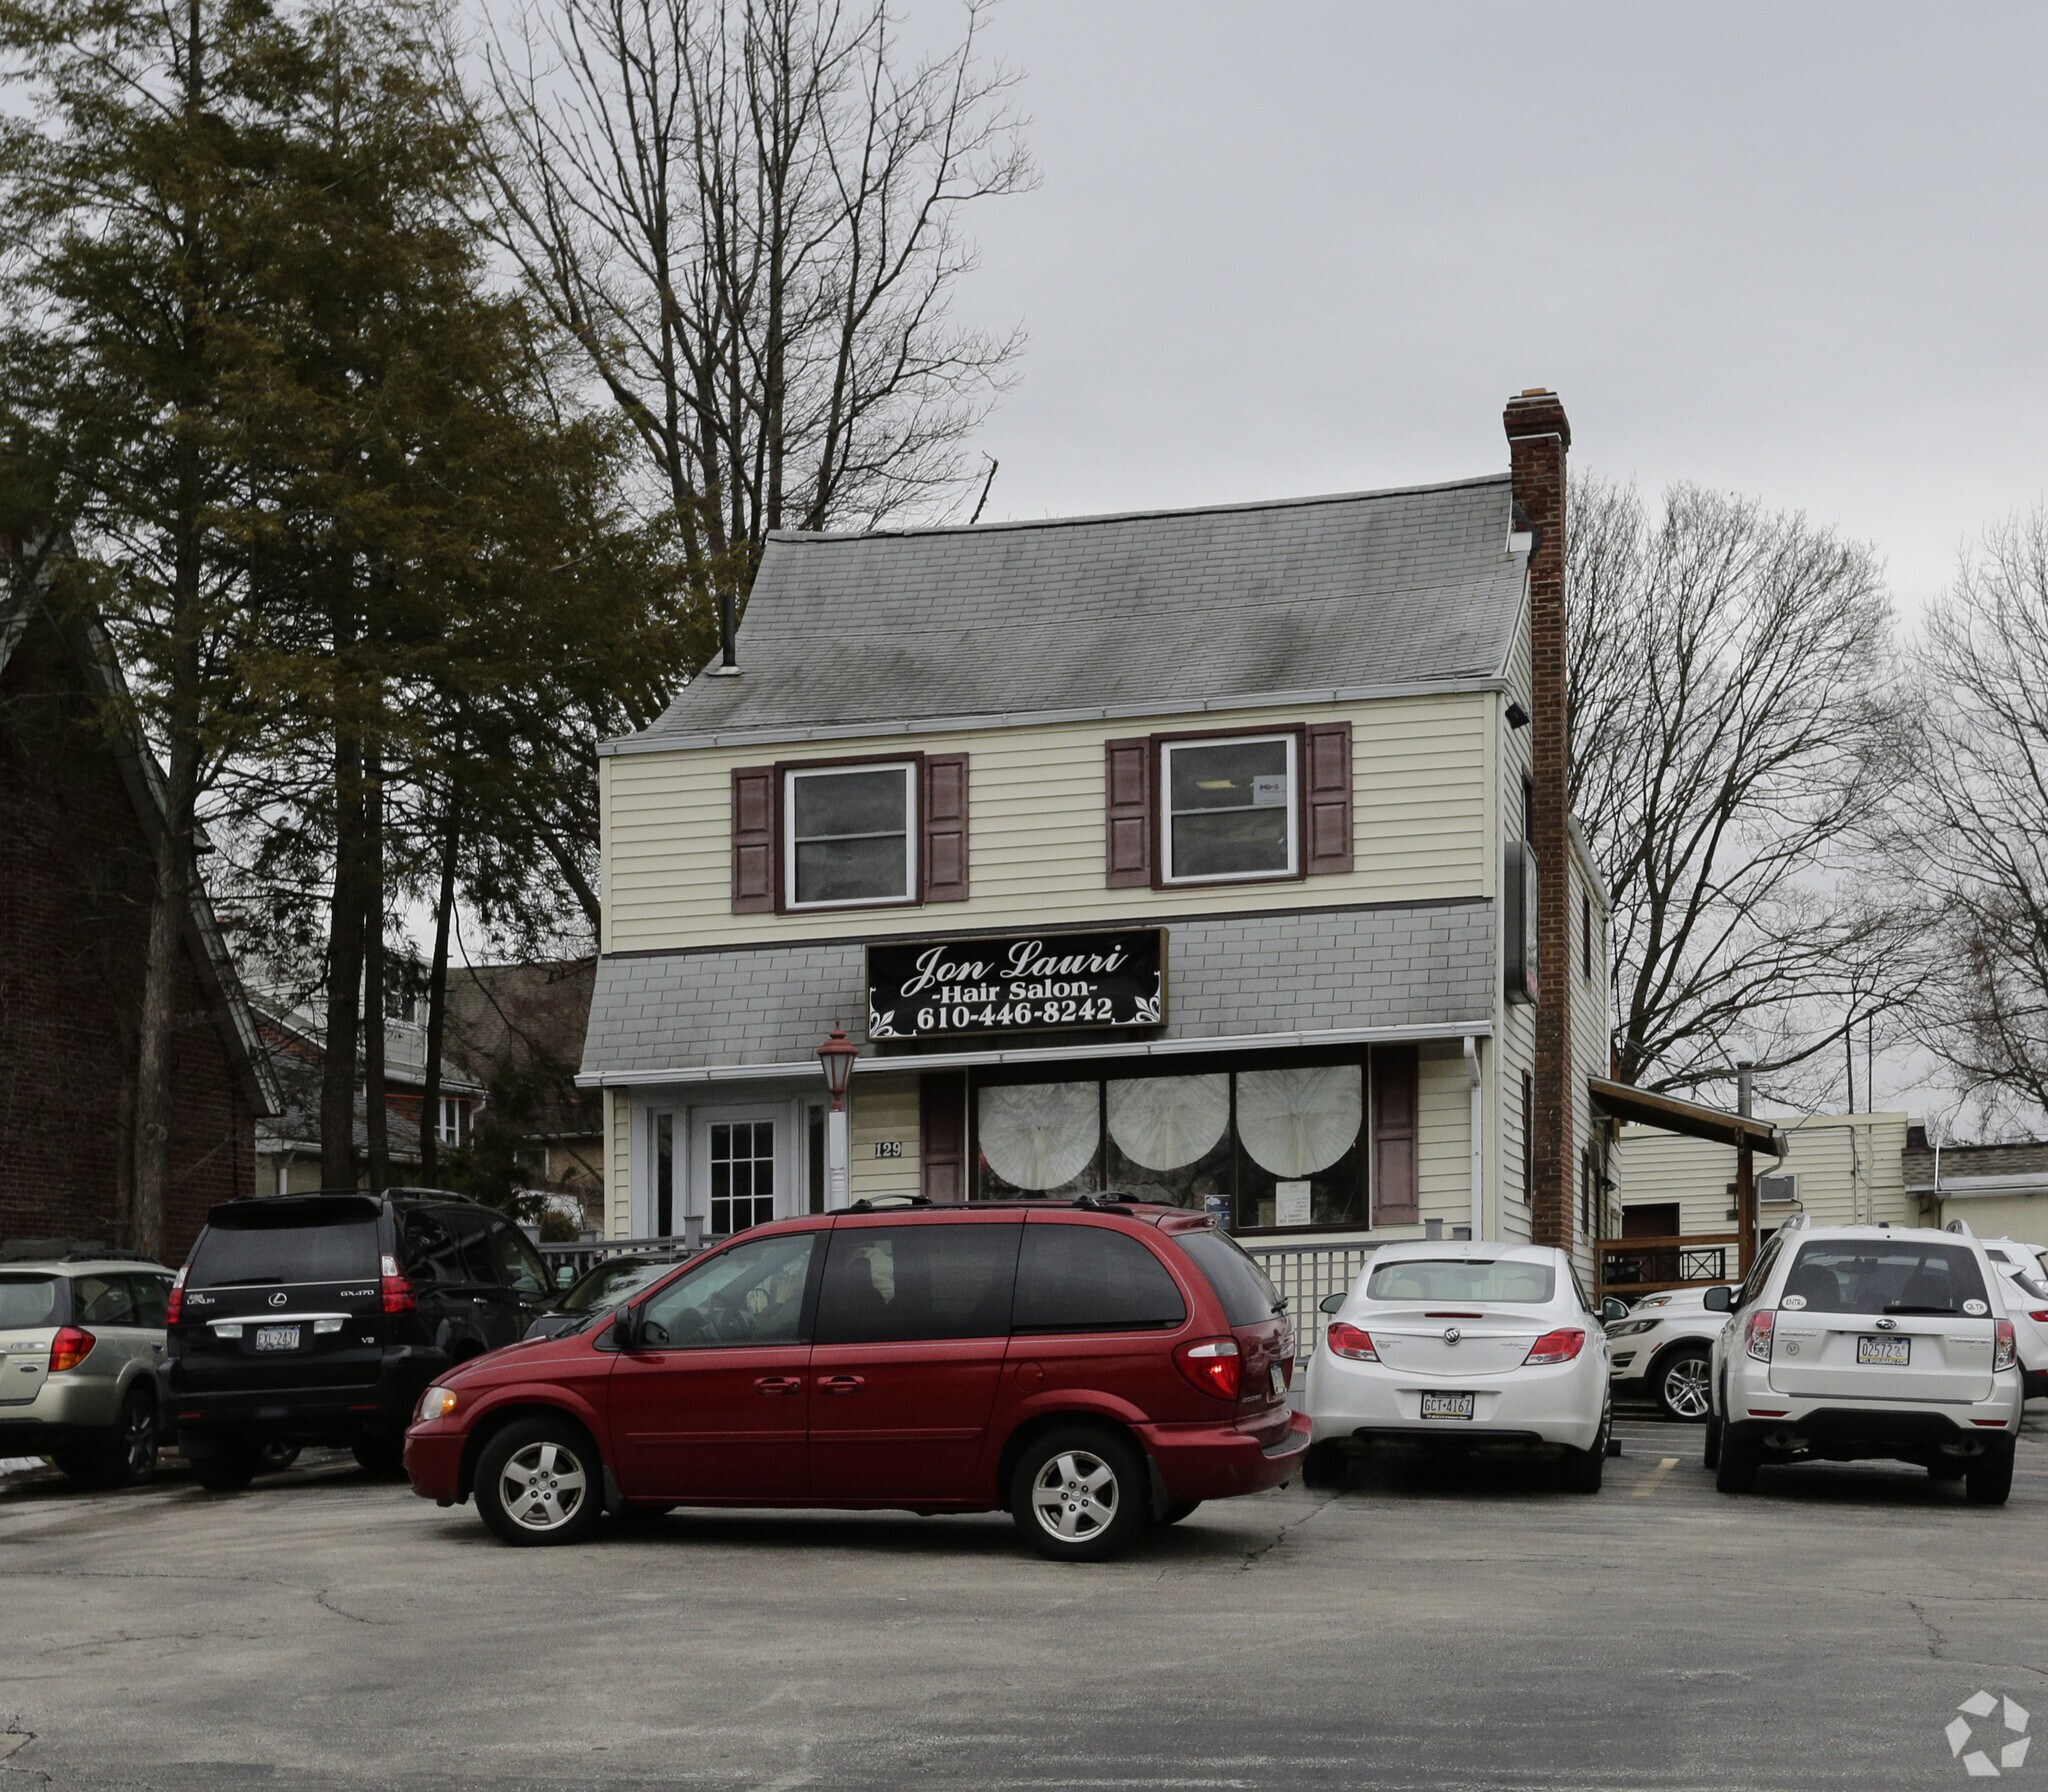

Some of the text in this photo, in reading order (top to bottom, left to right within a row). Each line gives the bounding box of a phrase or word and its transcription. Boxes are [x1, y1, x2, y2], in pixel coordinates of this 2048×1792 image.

[900, 940, 1129, 998] Jon Lauri
[917, 997, 1113, 1030] 610-446-8242
[875, 1141, 902, 1157] 129
[340, 1289, 375, 1297] GX470
[1862, 1343, 1893, 1357] 02572
